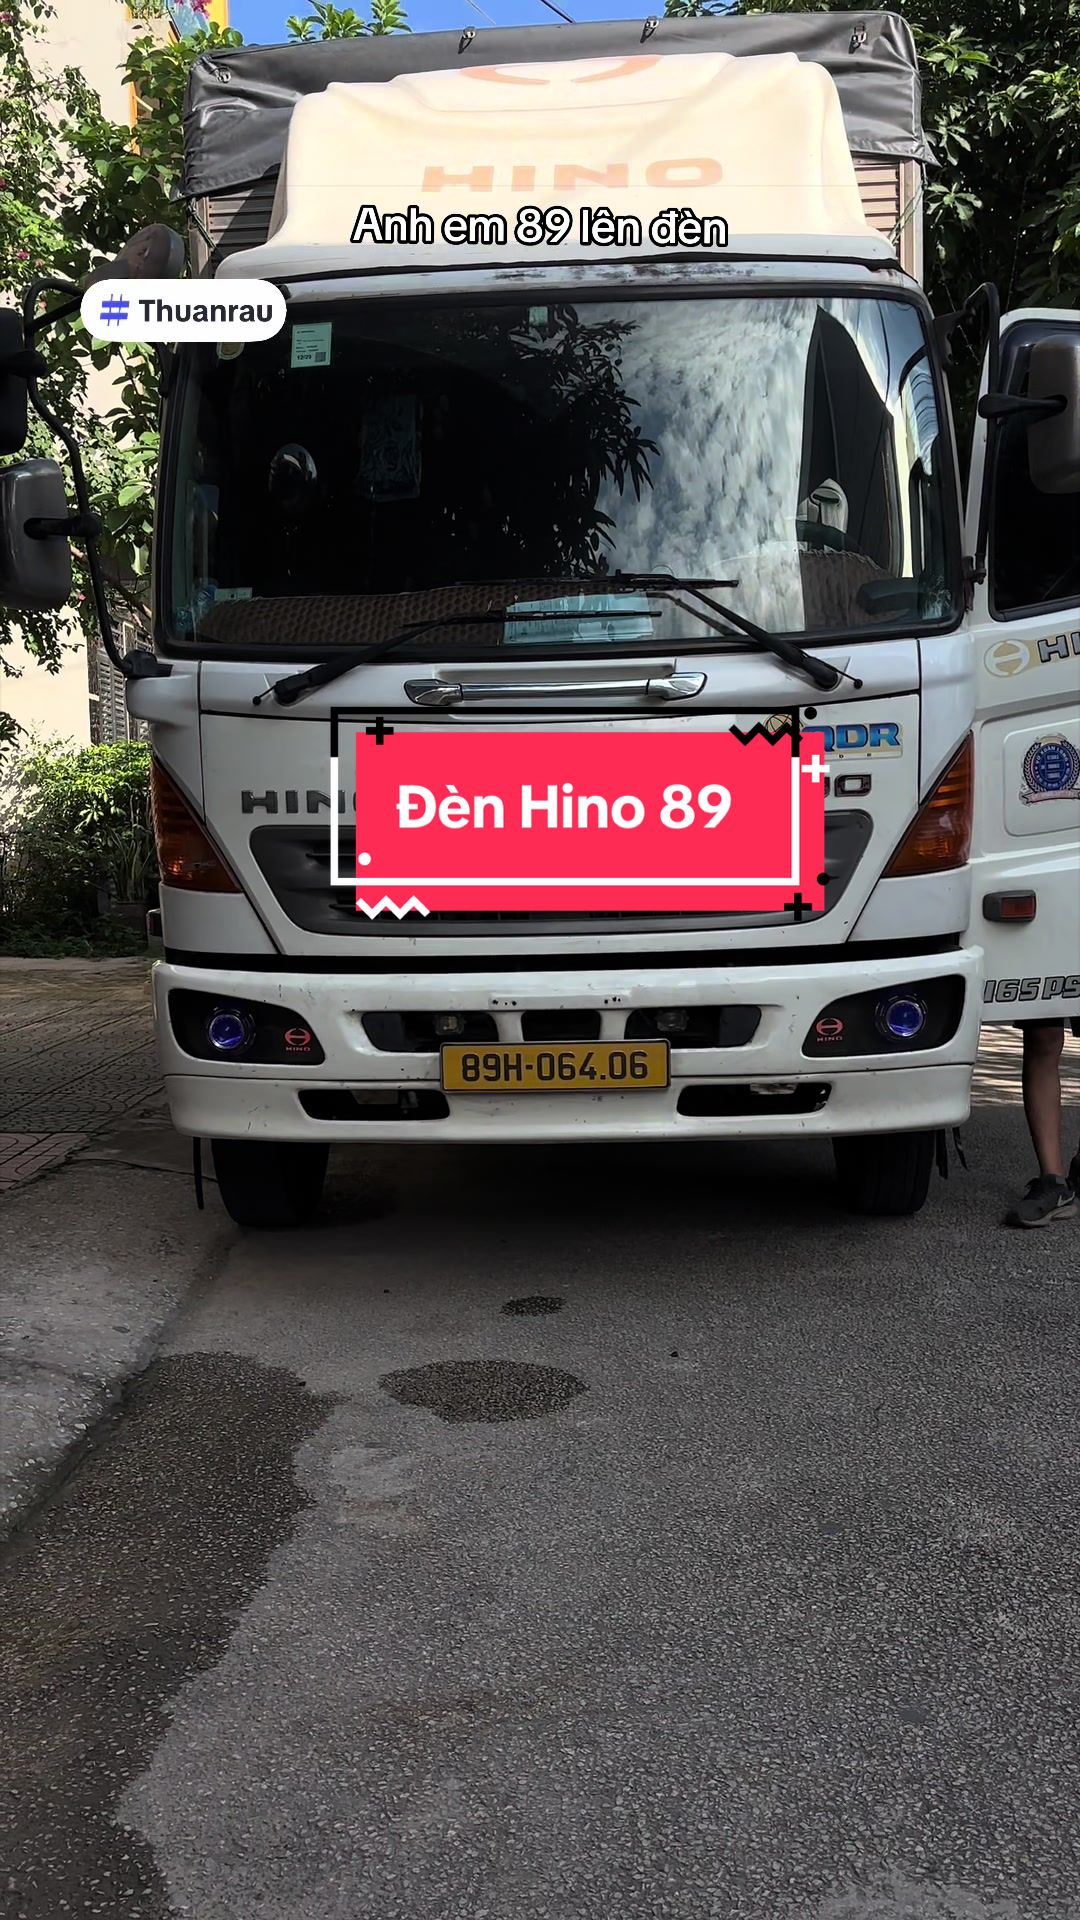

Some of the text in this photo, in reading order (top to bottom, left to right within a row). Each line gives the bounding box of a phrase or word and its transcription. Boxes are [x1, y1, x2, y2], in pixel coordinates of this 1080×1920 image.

[421, 157, 723, 192] HINO
[241, 790, 356, 814] HIN
[462, 1051, 648, 1081] 89H-064.06
